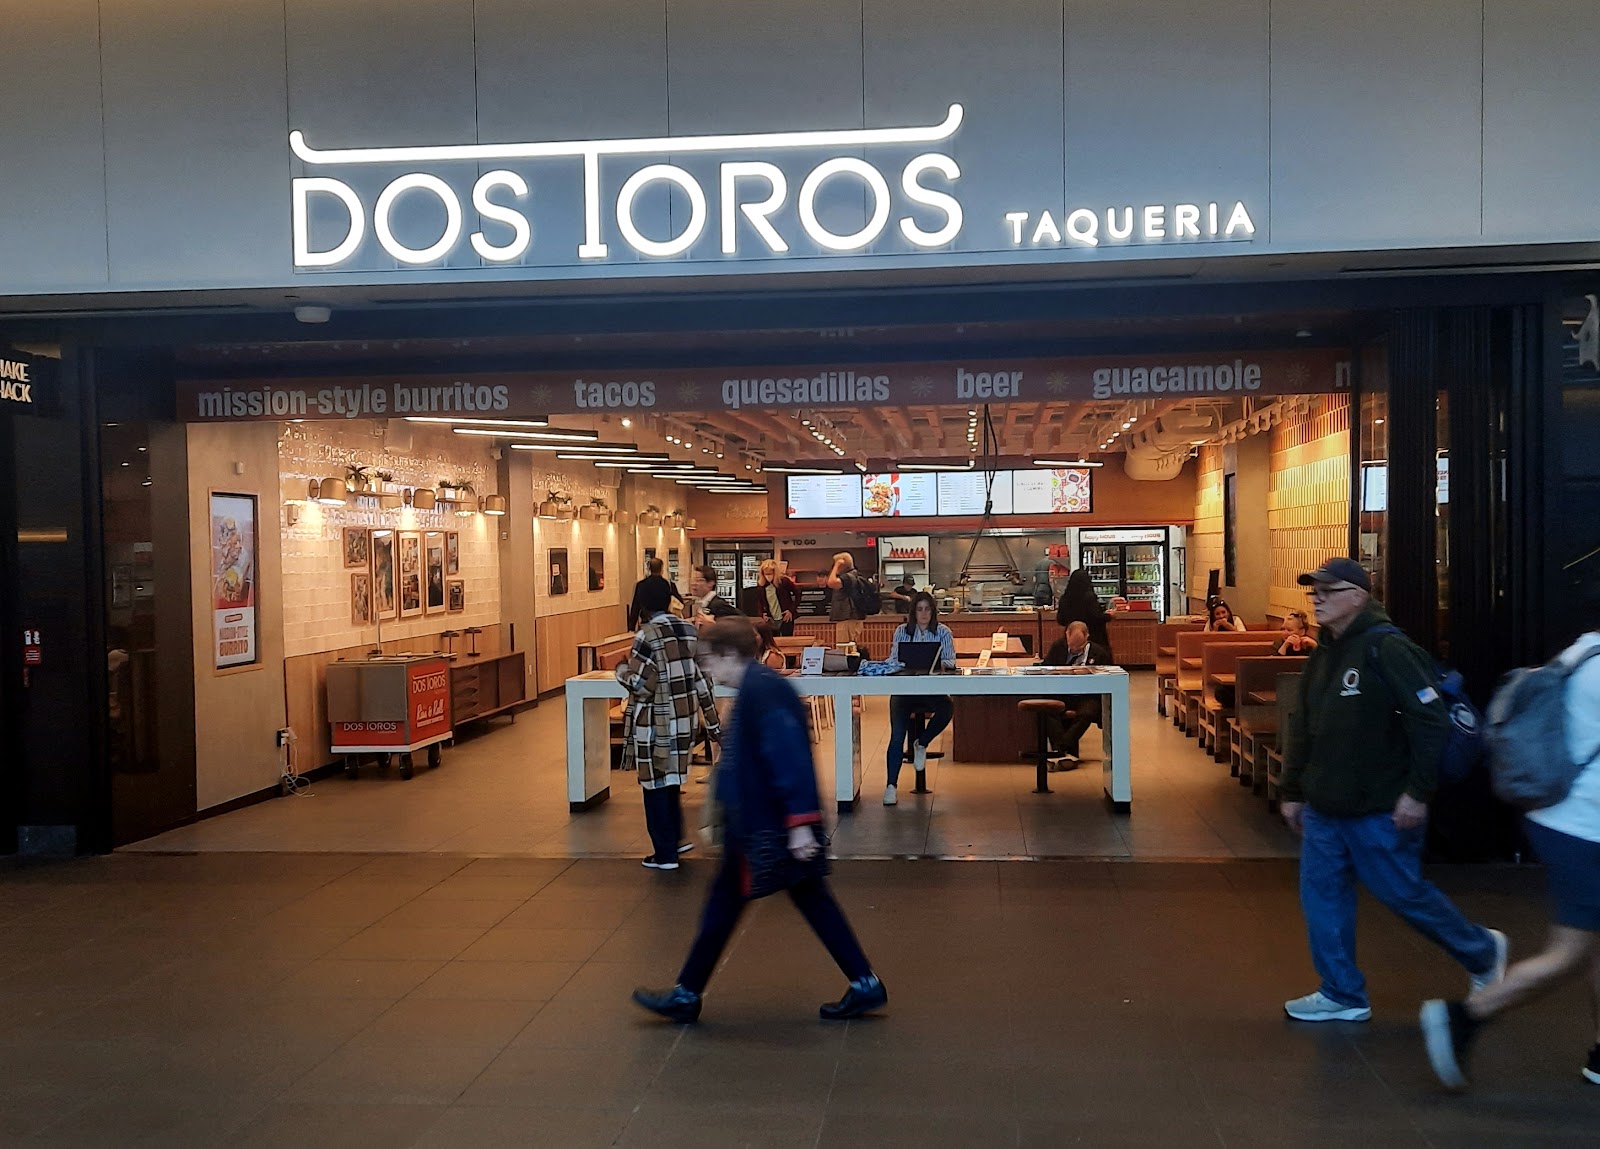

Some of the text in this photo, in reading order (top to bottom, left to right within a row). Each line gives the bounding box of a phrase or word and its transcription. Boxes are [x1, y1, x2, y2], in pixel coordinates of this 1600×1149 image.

[292, 103, 965, 267] DOS TOROS
[1005, 200, 1256, 247] TAQUERIA
[198, 383, 387, 418] mission-style
[393, 381, 509, 413] burritos
[573, 378, 657, 408] tacos
[721, 371, 890, 409] quesadillas
[956, 367, 1024, 398] beer
[1092, 359, 1262, 399] guacamole
[412, 678, 427, 694] DOS
[343, 722, 364, 731] DOS
